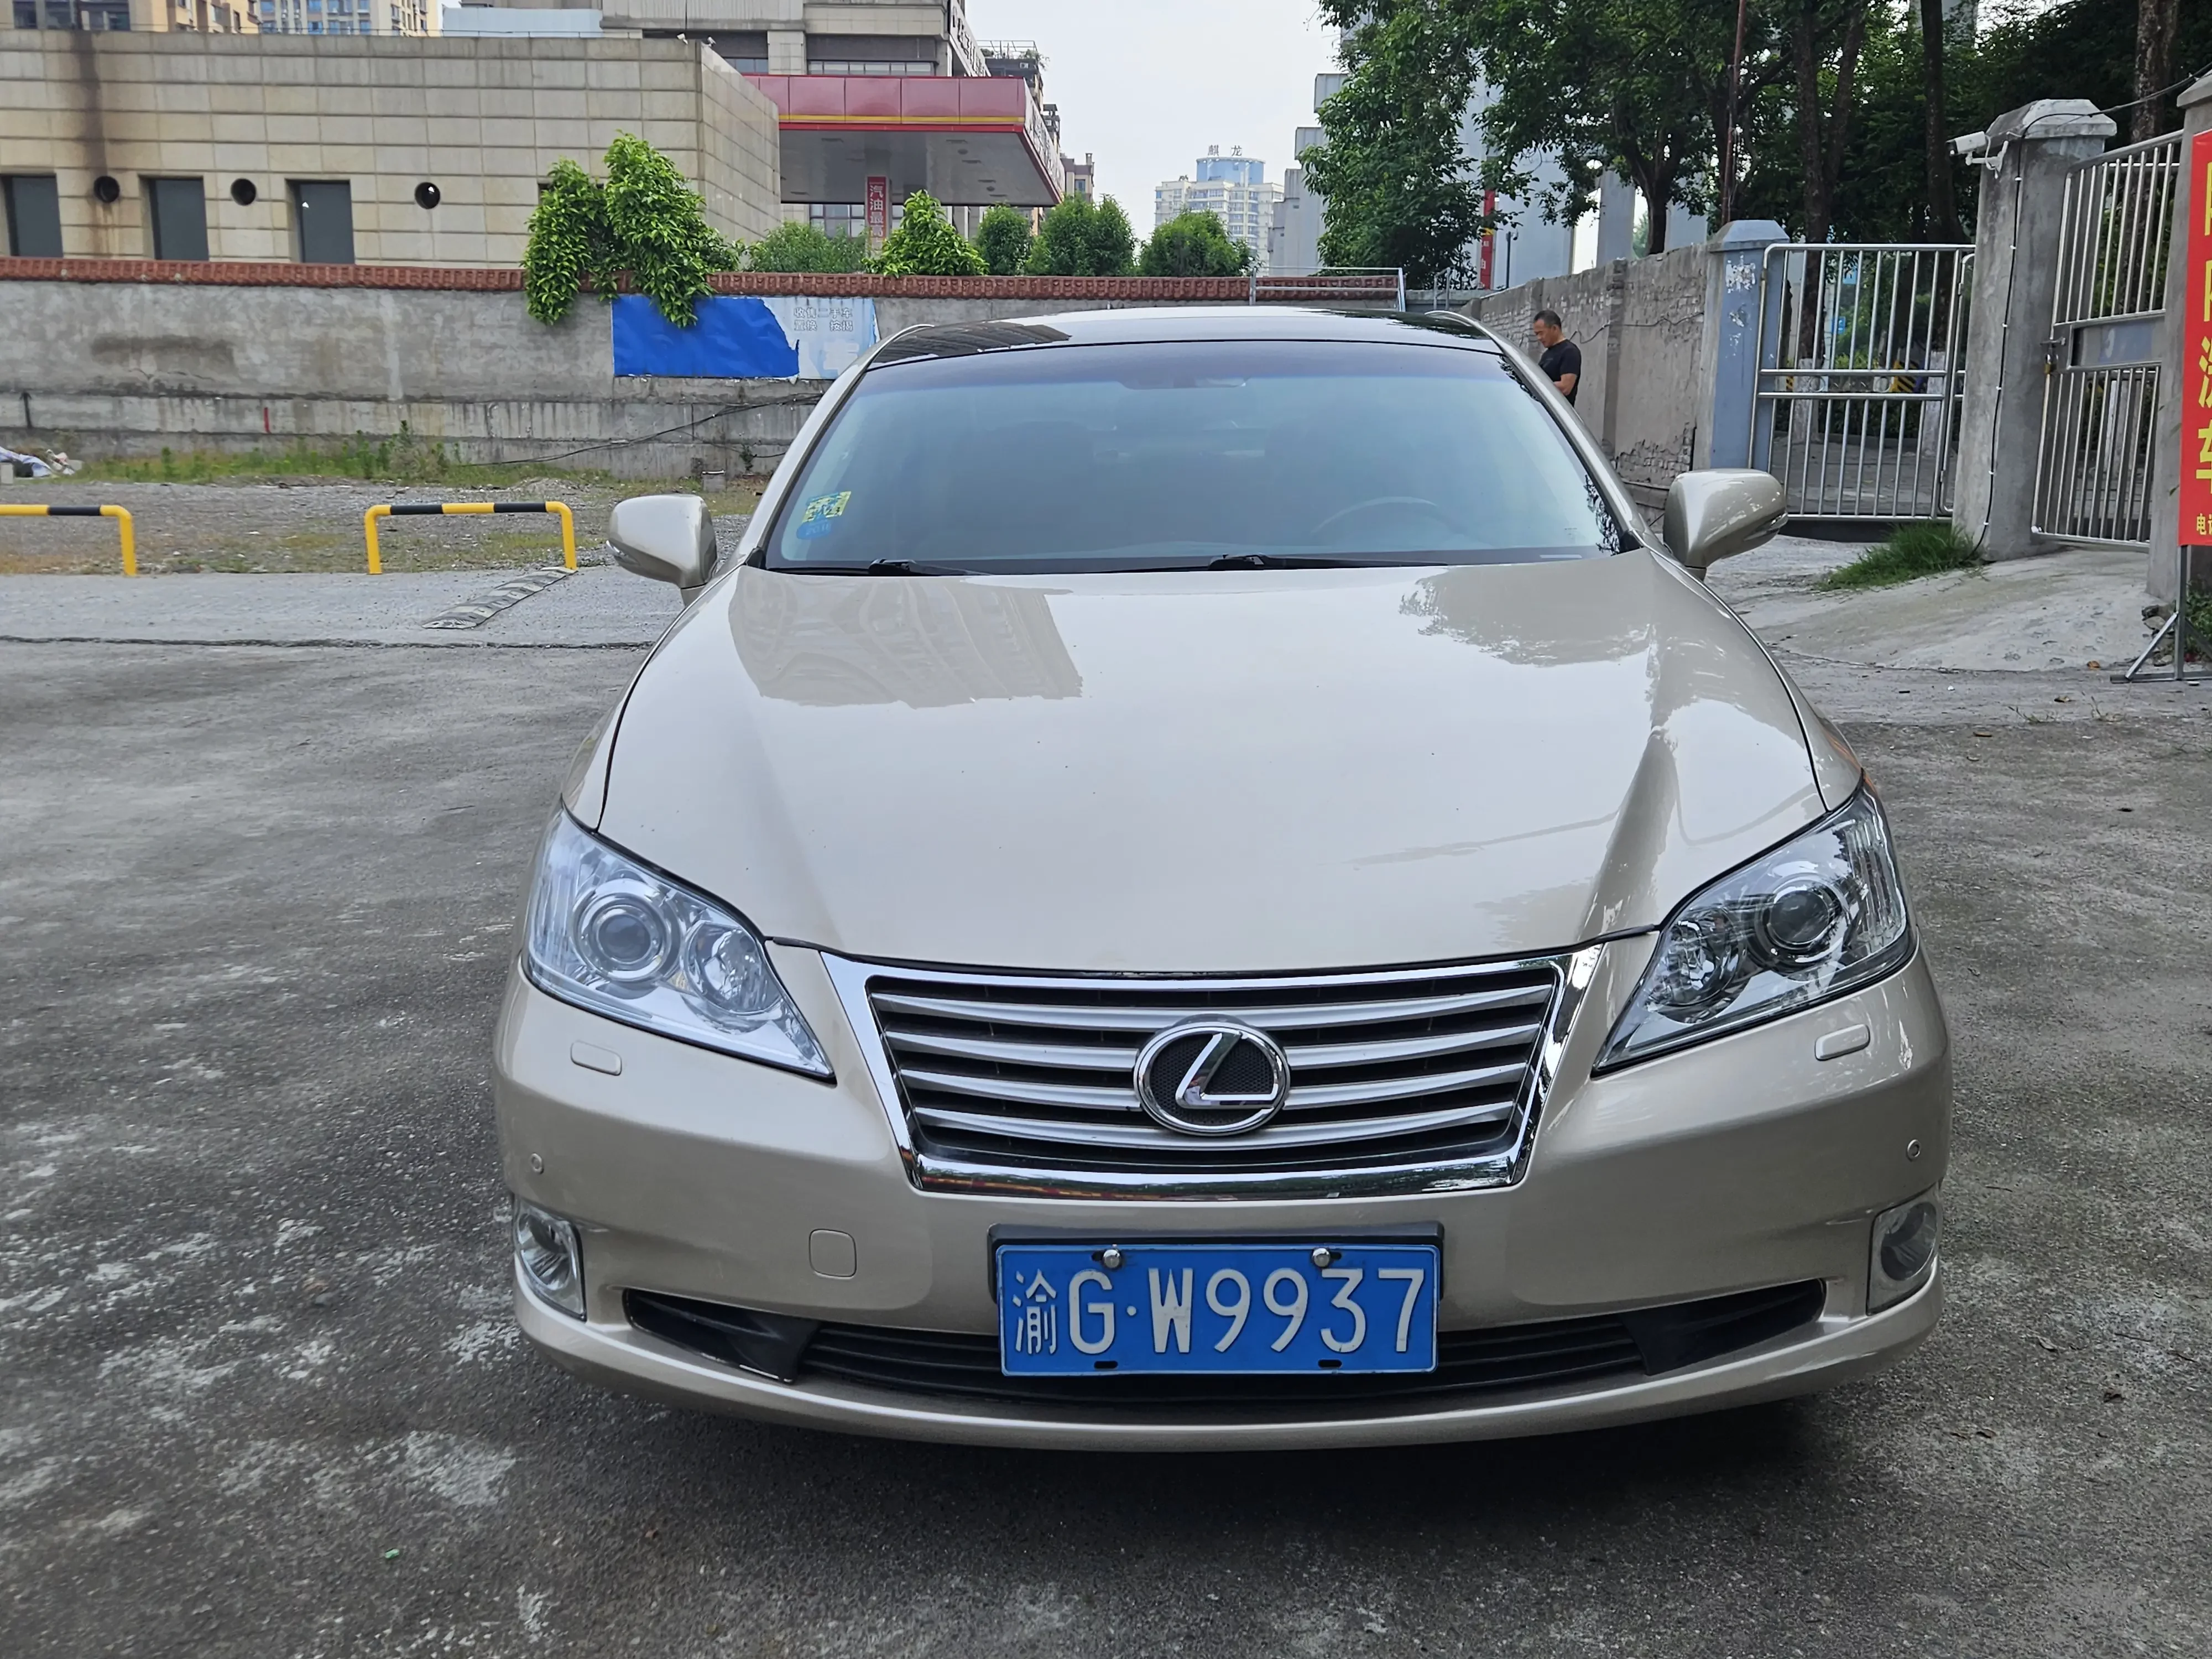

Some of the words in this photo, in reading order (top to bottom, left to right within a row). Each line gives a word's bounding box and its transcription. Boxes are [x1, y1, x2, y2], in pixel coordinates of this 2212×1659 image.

[794, 307, 853, 319] 收售二手车
